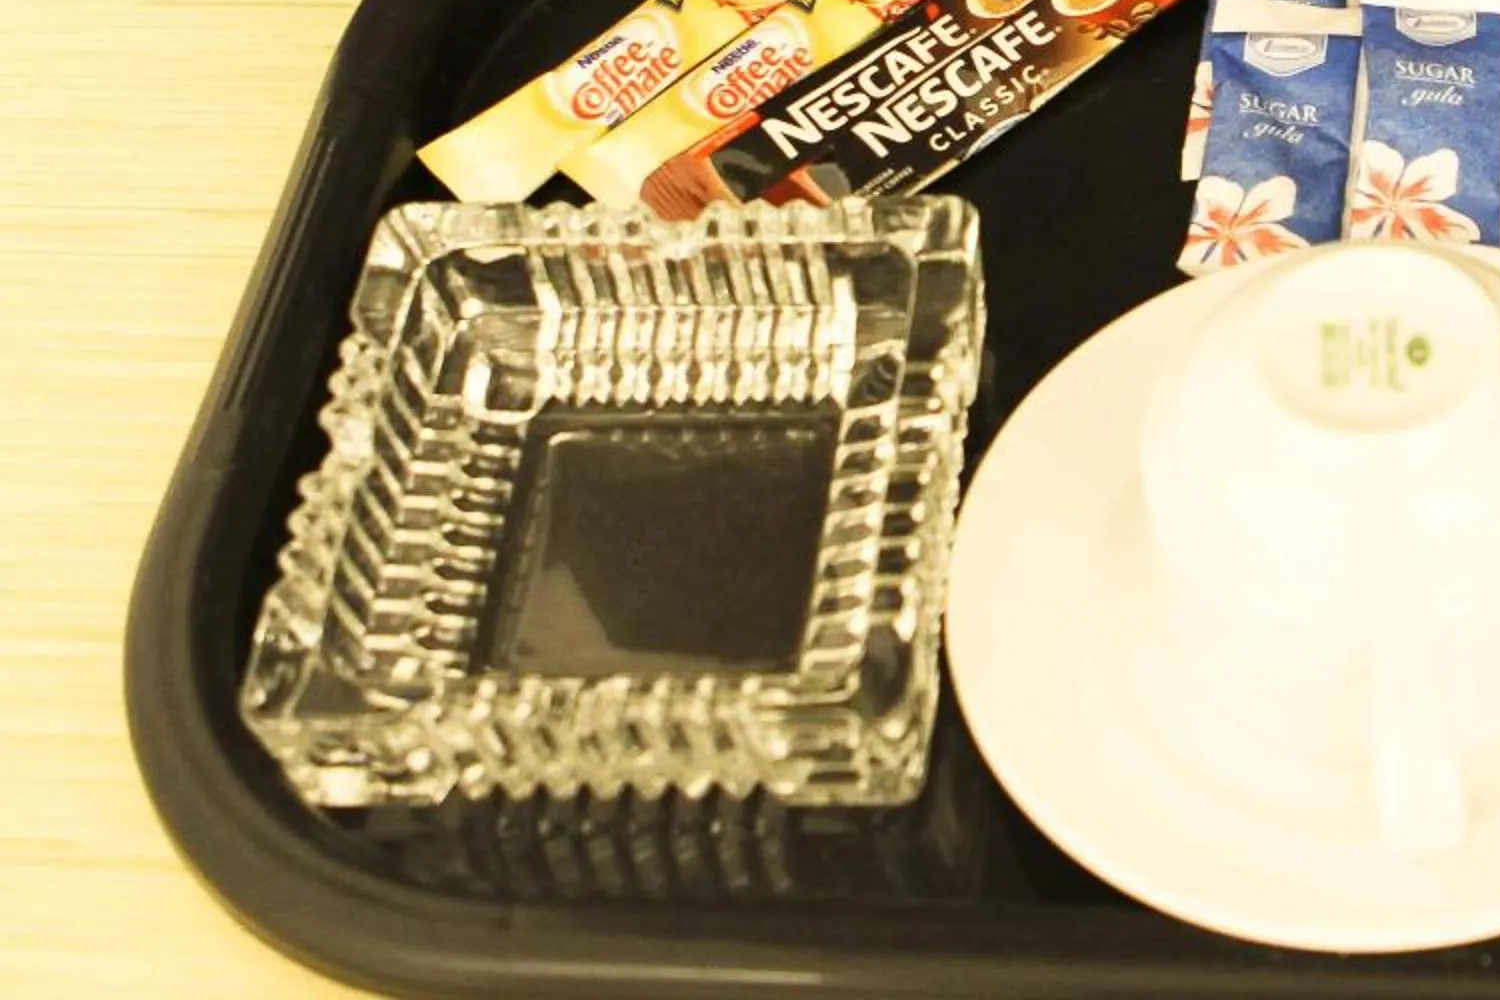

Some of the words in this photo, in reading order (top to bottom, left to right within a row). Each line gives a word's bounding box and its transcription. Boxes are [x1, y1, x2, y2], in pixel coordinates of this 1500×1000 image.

[1395, 60, 1477, 84] SUGAR
[929, 64, 1042, 152] CLASSIC
[1240, 93, 1319, 123] SUGAR
